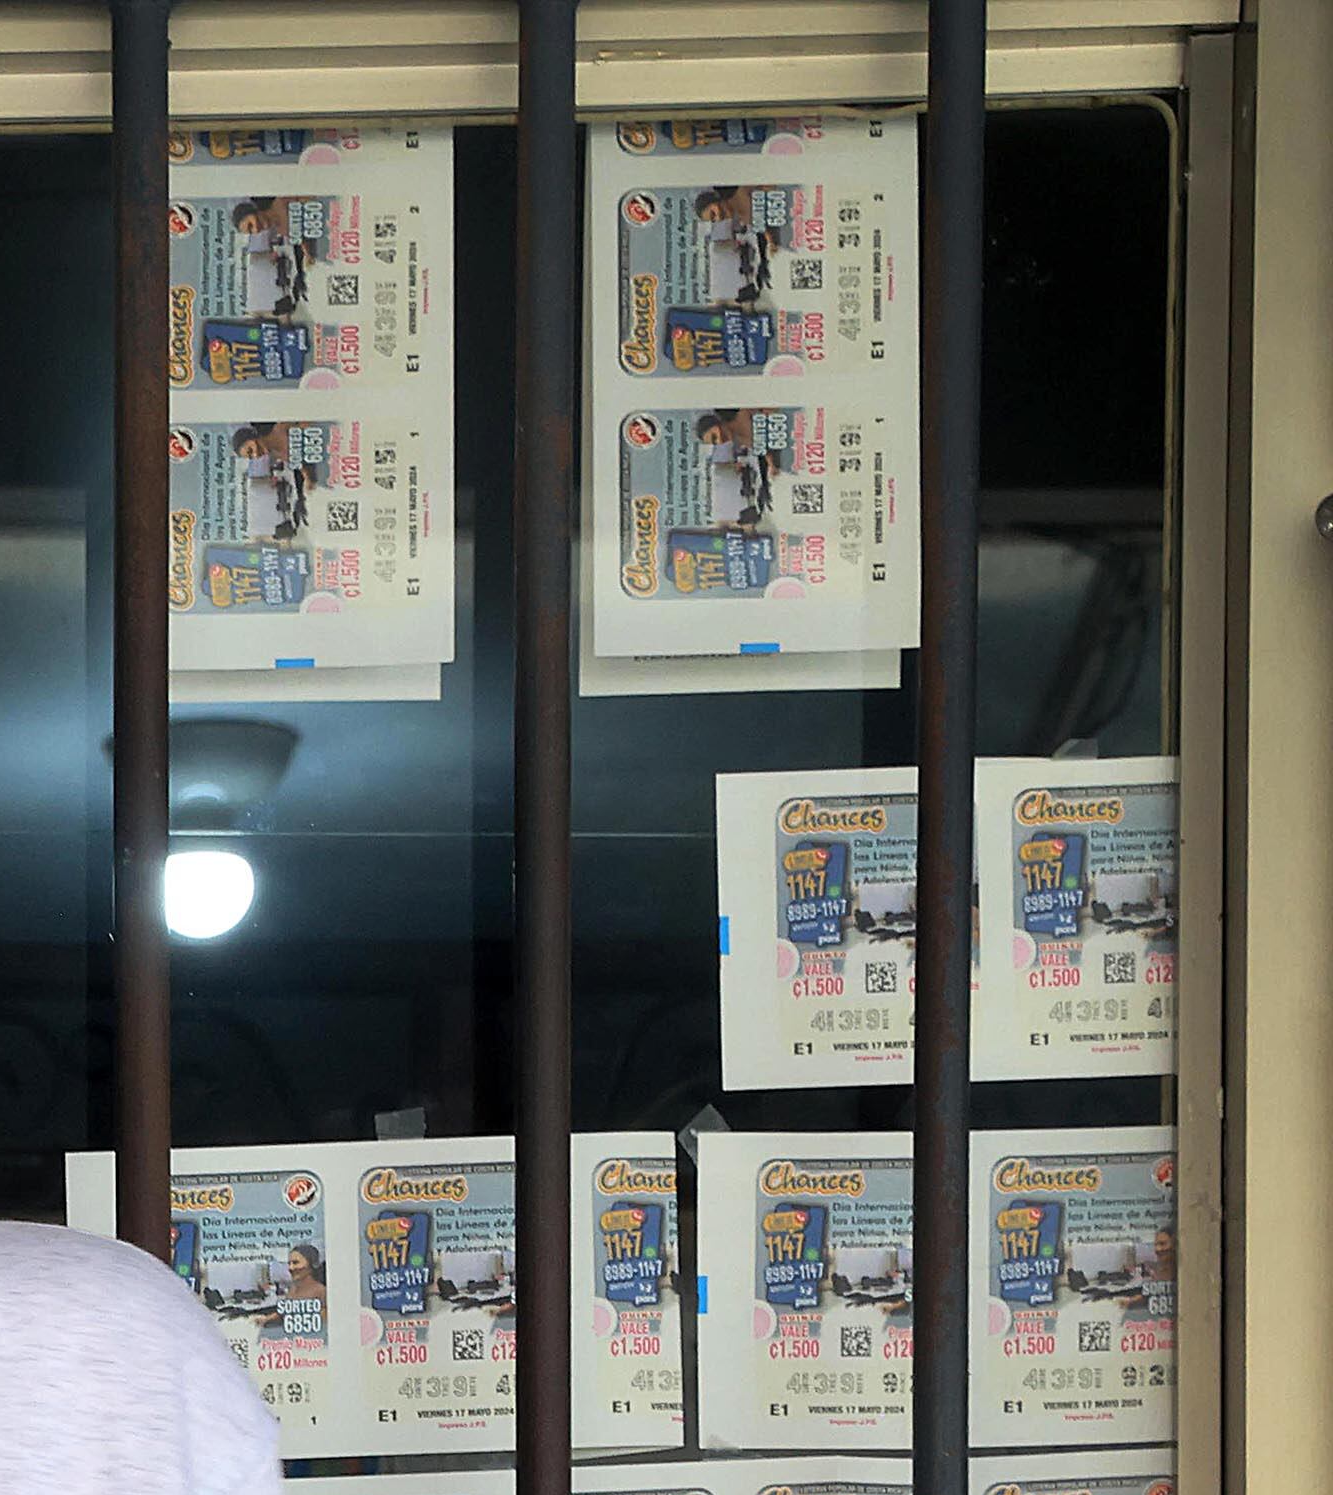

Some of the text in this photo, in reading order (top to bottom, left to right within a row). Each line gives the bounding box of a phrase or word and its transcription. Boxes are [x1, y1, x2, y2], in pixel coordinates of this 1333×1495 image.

[620, 273, 659, 372] Chances
[768, 413, 787, 448] 6850
[622, 496, 660, 594] Chances
[872, 563, 884, 581] E1
[781, 796, 886, 837] Chances
[1018, 787, 1123, 828] Chances
[786, 869, 826, 900] 1147
[364, 1165, 467, 1206] Chances
[761, 1161, 865, 1198] Chances
[995, 1156, 1101, 1195] Chances
[369, 1238, 409, 1269] 1147
[370, 1268, 429, 1291] 8989-1147
[277, 1299, 321, 1314] SORTEO
[284, 1313, 321, 1333] 6850
